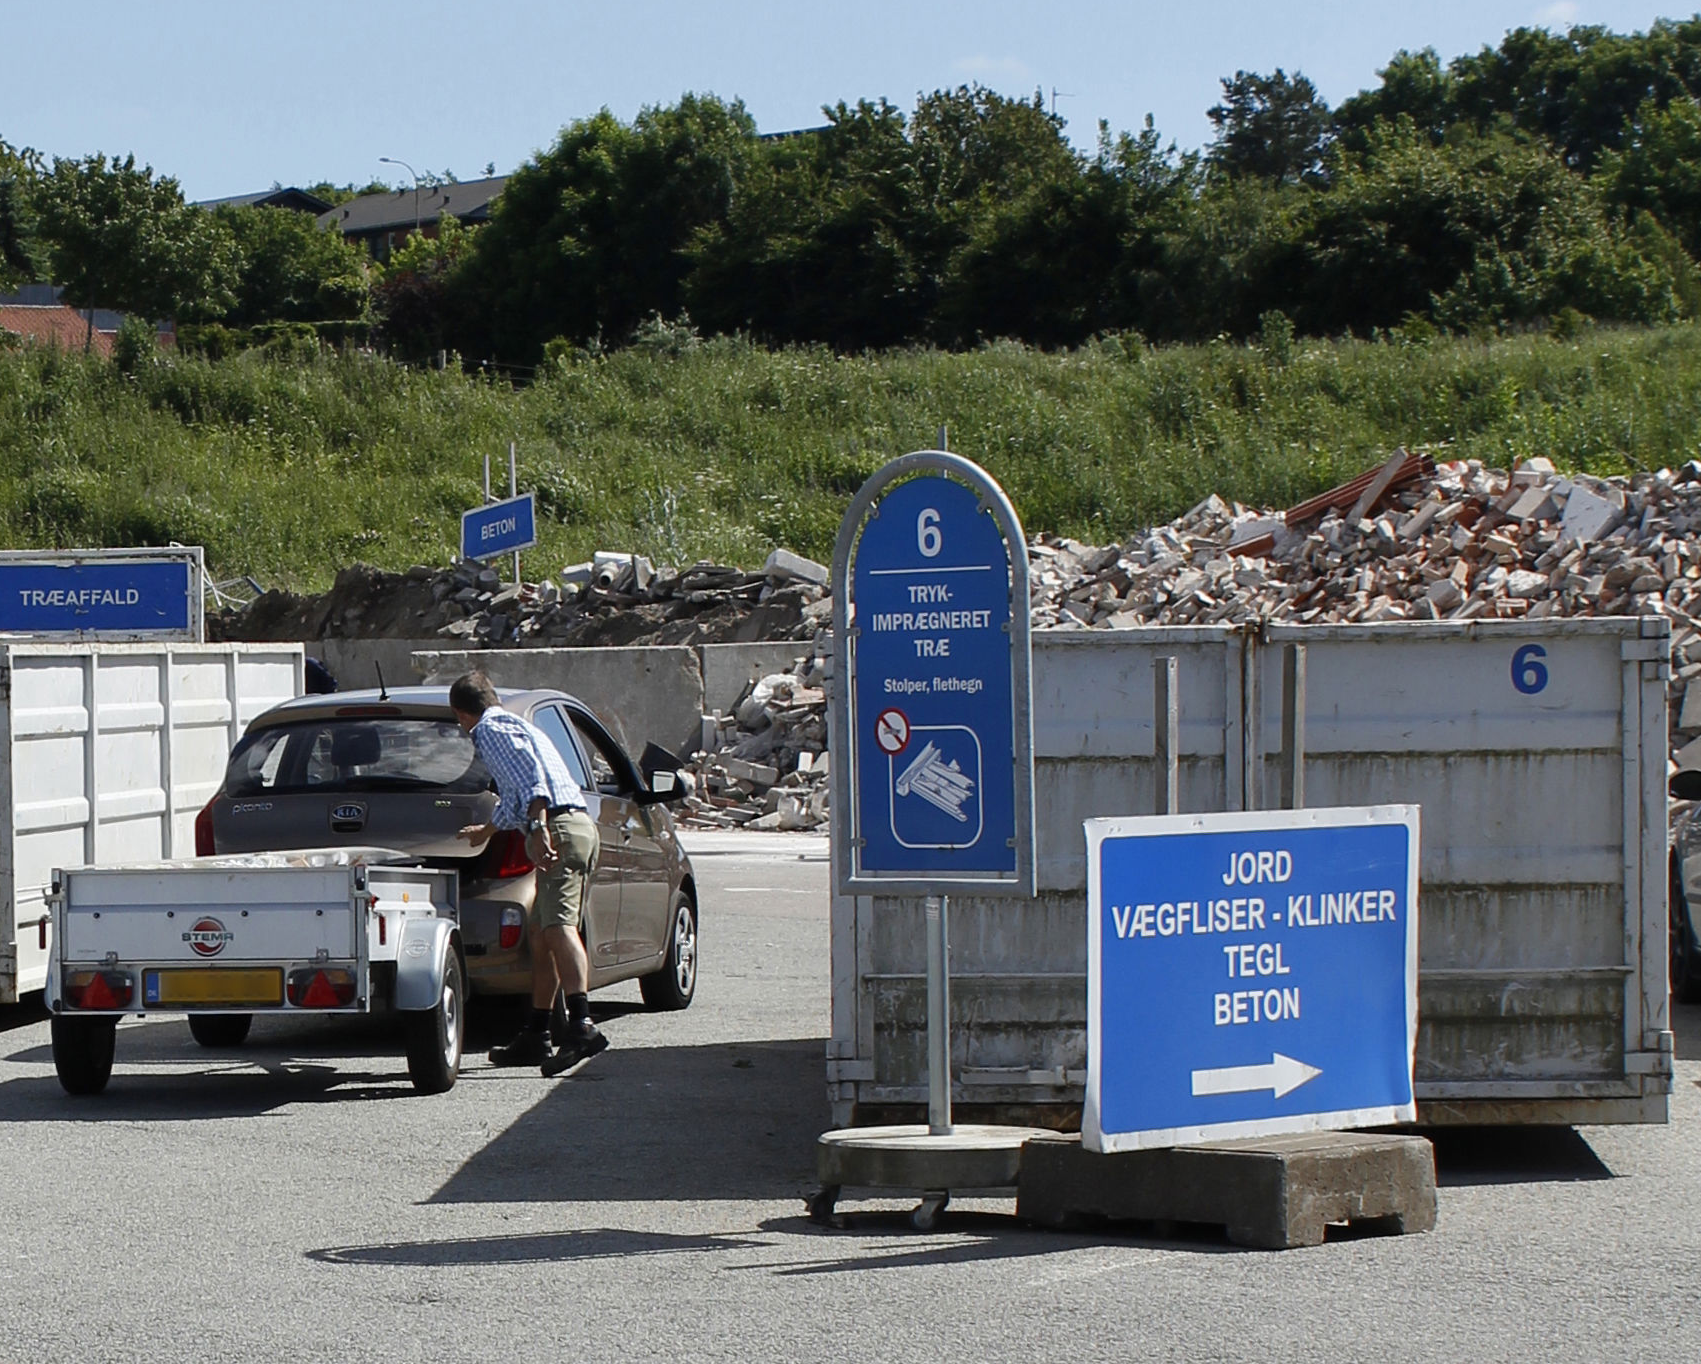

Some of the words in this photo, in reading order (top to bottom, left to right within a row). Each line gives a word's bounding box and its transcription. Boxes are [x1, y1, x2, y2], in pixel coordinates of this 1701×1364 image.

[481, 516, 516, 541] BETON
[917, 507, 942, 558] 6
[19, 589, 139, 607] TRÆAFFALD
[908, 584, 953, 604] TRYK-
[872, 610, 991, 632] IMPRÆGNERET
[913, 638, 950, 657] TRÆ
[1510, 643, 1549, 695] 6
[884, 678, 930, 695] Stolper,
[932, 677, 983, 694] flethegn
[1222, 850, 1292, 886] JORD
[1111, 898, 1266, 939] VÆGFLISER
[1287, 889, 1397, 928] KLINKER
[1223, 942, 1291, 978] TEGL
[1213, 987, 1300, 1026] BETON
